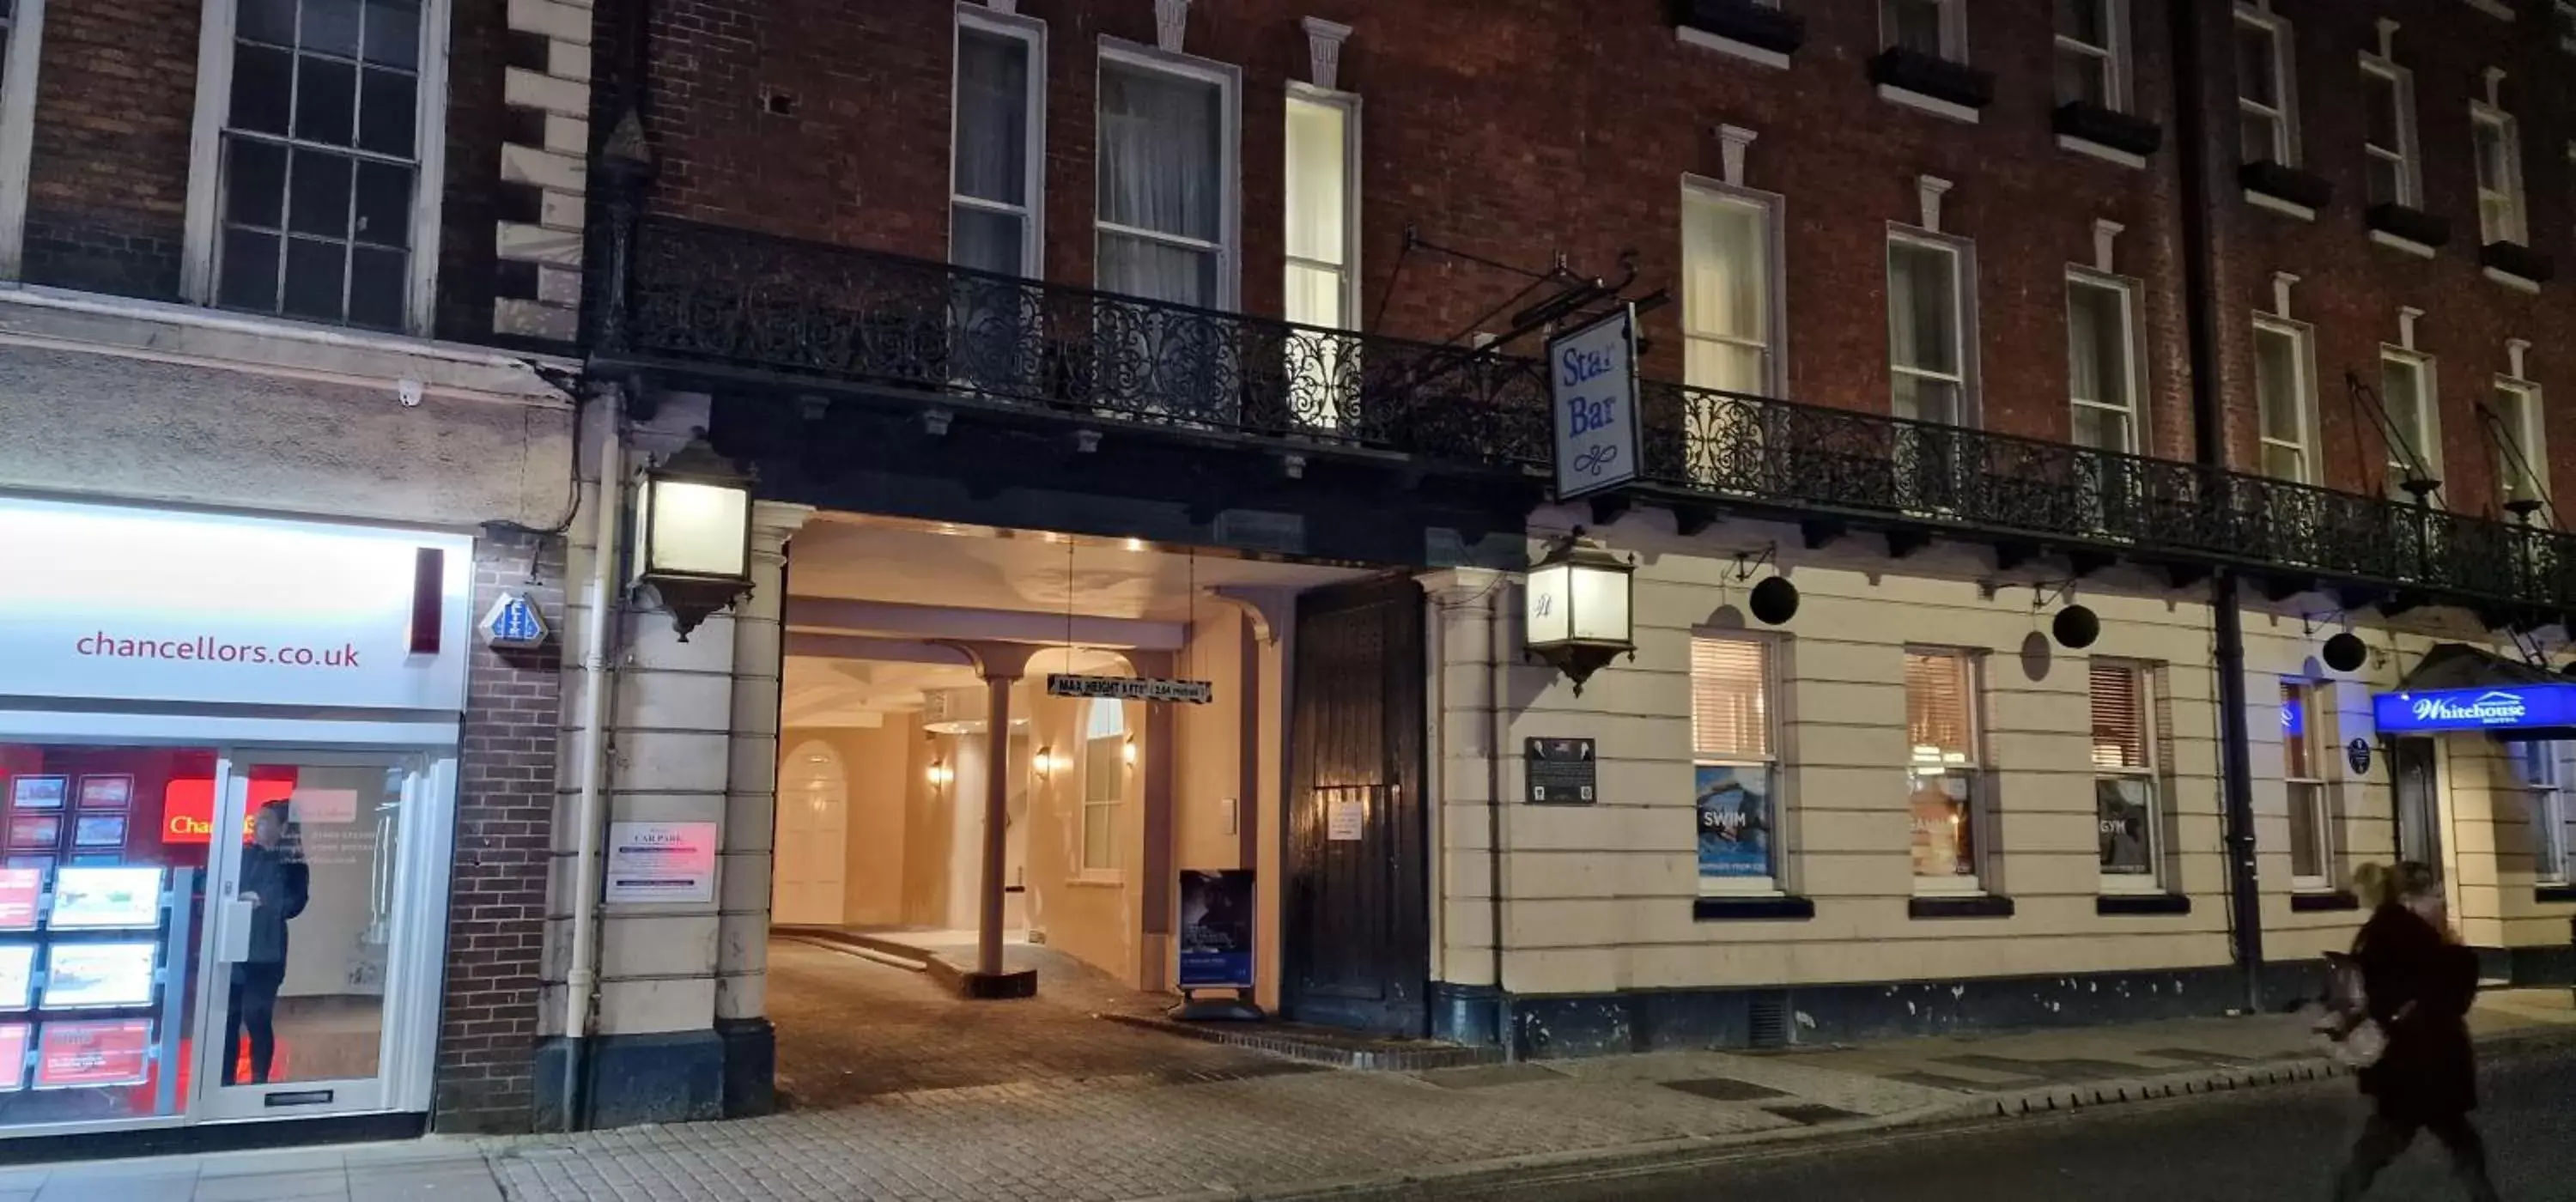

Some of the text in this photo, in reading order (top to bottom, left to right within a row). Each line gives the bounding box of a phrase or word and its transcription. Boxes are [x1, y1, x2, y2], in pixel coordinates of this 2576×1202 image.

[1562, 343, 1614, 387] Star
[1567, 395, 1616, 439] Bar
[76, 630, 360, 667] chancellors.co.uk
[1059, 679, 1082, 692] MAX
[1084, 680, 1120, 695] HEIGHT
[2412, 697, 2526, 720] Whitehouse
[1704, 811, 1747, 827] SWIM
[2099, 819, 2126, 833] GYM
